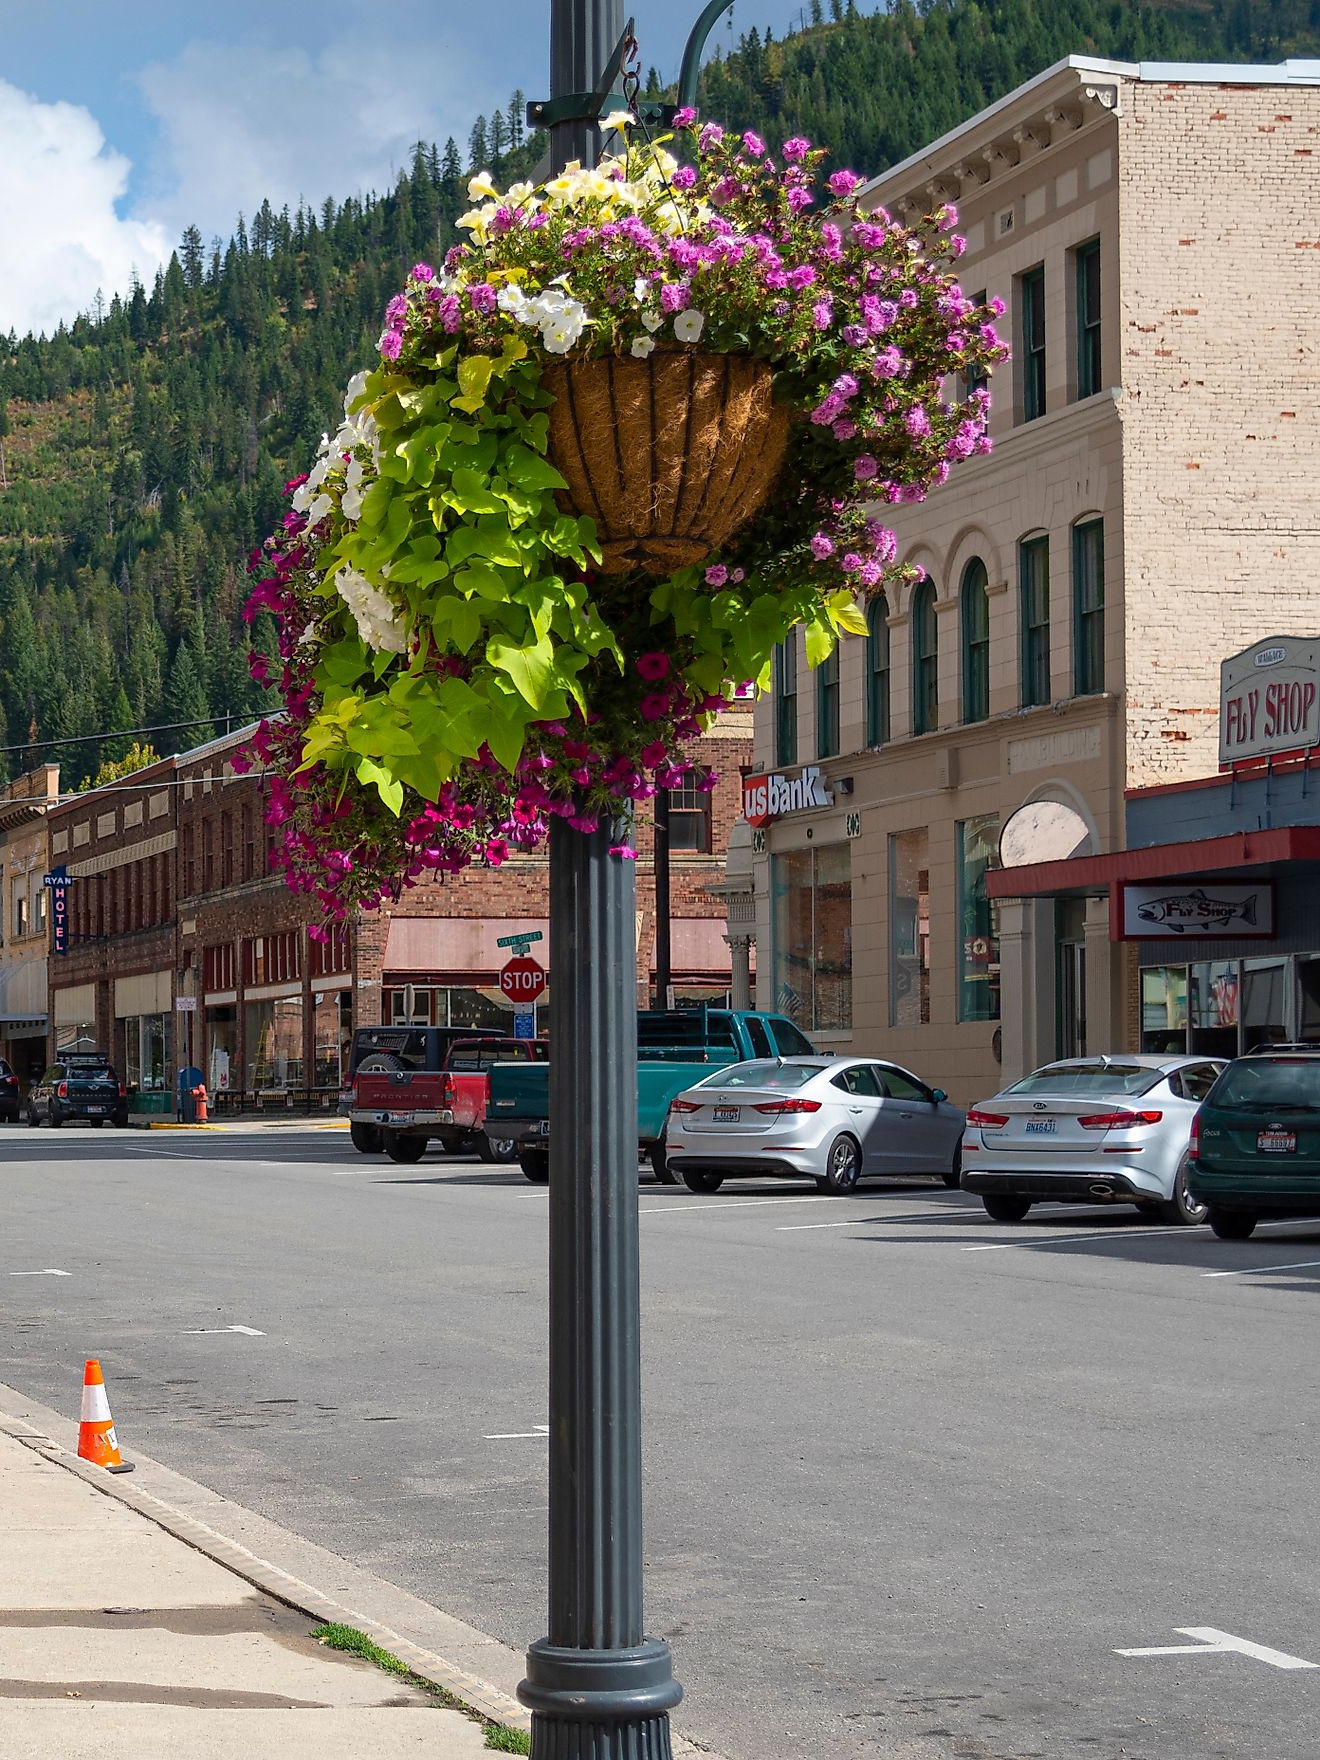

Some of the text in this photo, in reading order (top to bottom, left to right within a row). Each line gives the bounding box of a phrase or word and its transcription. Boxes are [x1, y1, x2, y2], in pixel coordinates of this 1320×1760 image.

[1226, 682, 1316, 747] FLY SHOP
[44, 877, 72, 885] RYAN
[55, 888, 65, 951] HOTEL
[519, 932, 540, 943] STREET
[503, 971, 542, 990] STOP
